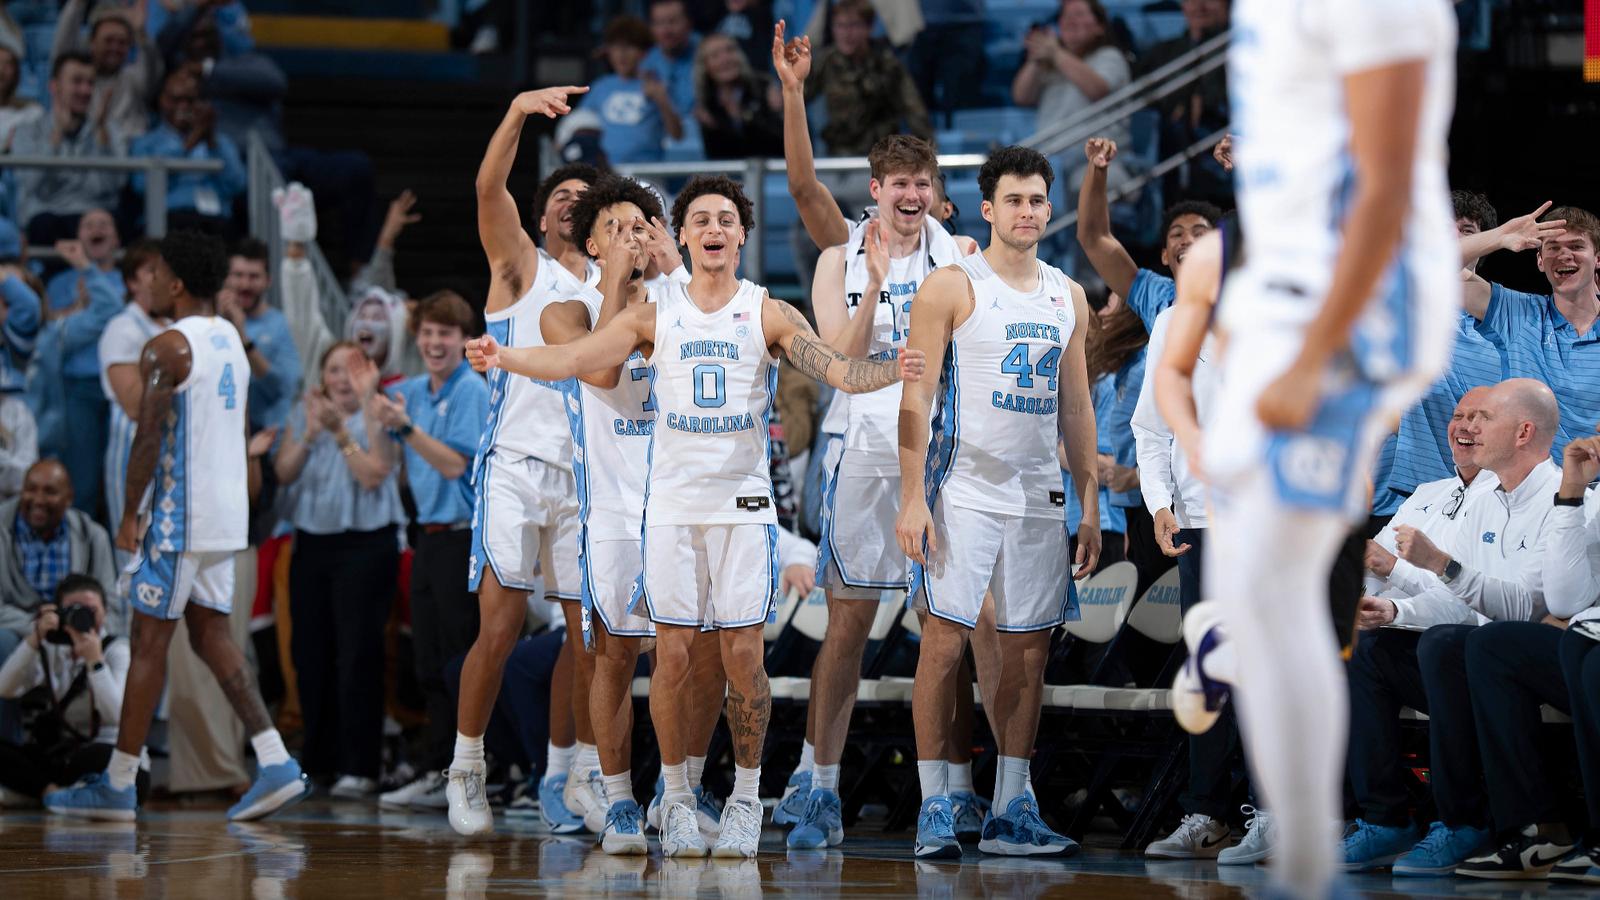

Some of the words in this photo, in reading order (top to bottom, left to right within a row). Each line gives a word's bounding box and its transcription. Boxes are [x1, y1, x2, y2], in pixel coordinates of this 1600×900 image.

[848, 291, 892, 306] TR
[1005, 322, 1061, 343] NORTH
[680, 340, 740, 360] NORTH
[1000, 342, 1062, 392] 44
[217, 363, 236, 410] 4
[692, 363, 727, 408] 0
[991, 390, 1058, 415] CAROLIN
[666, 412, 755, 433] CAROLINA
